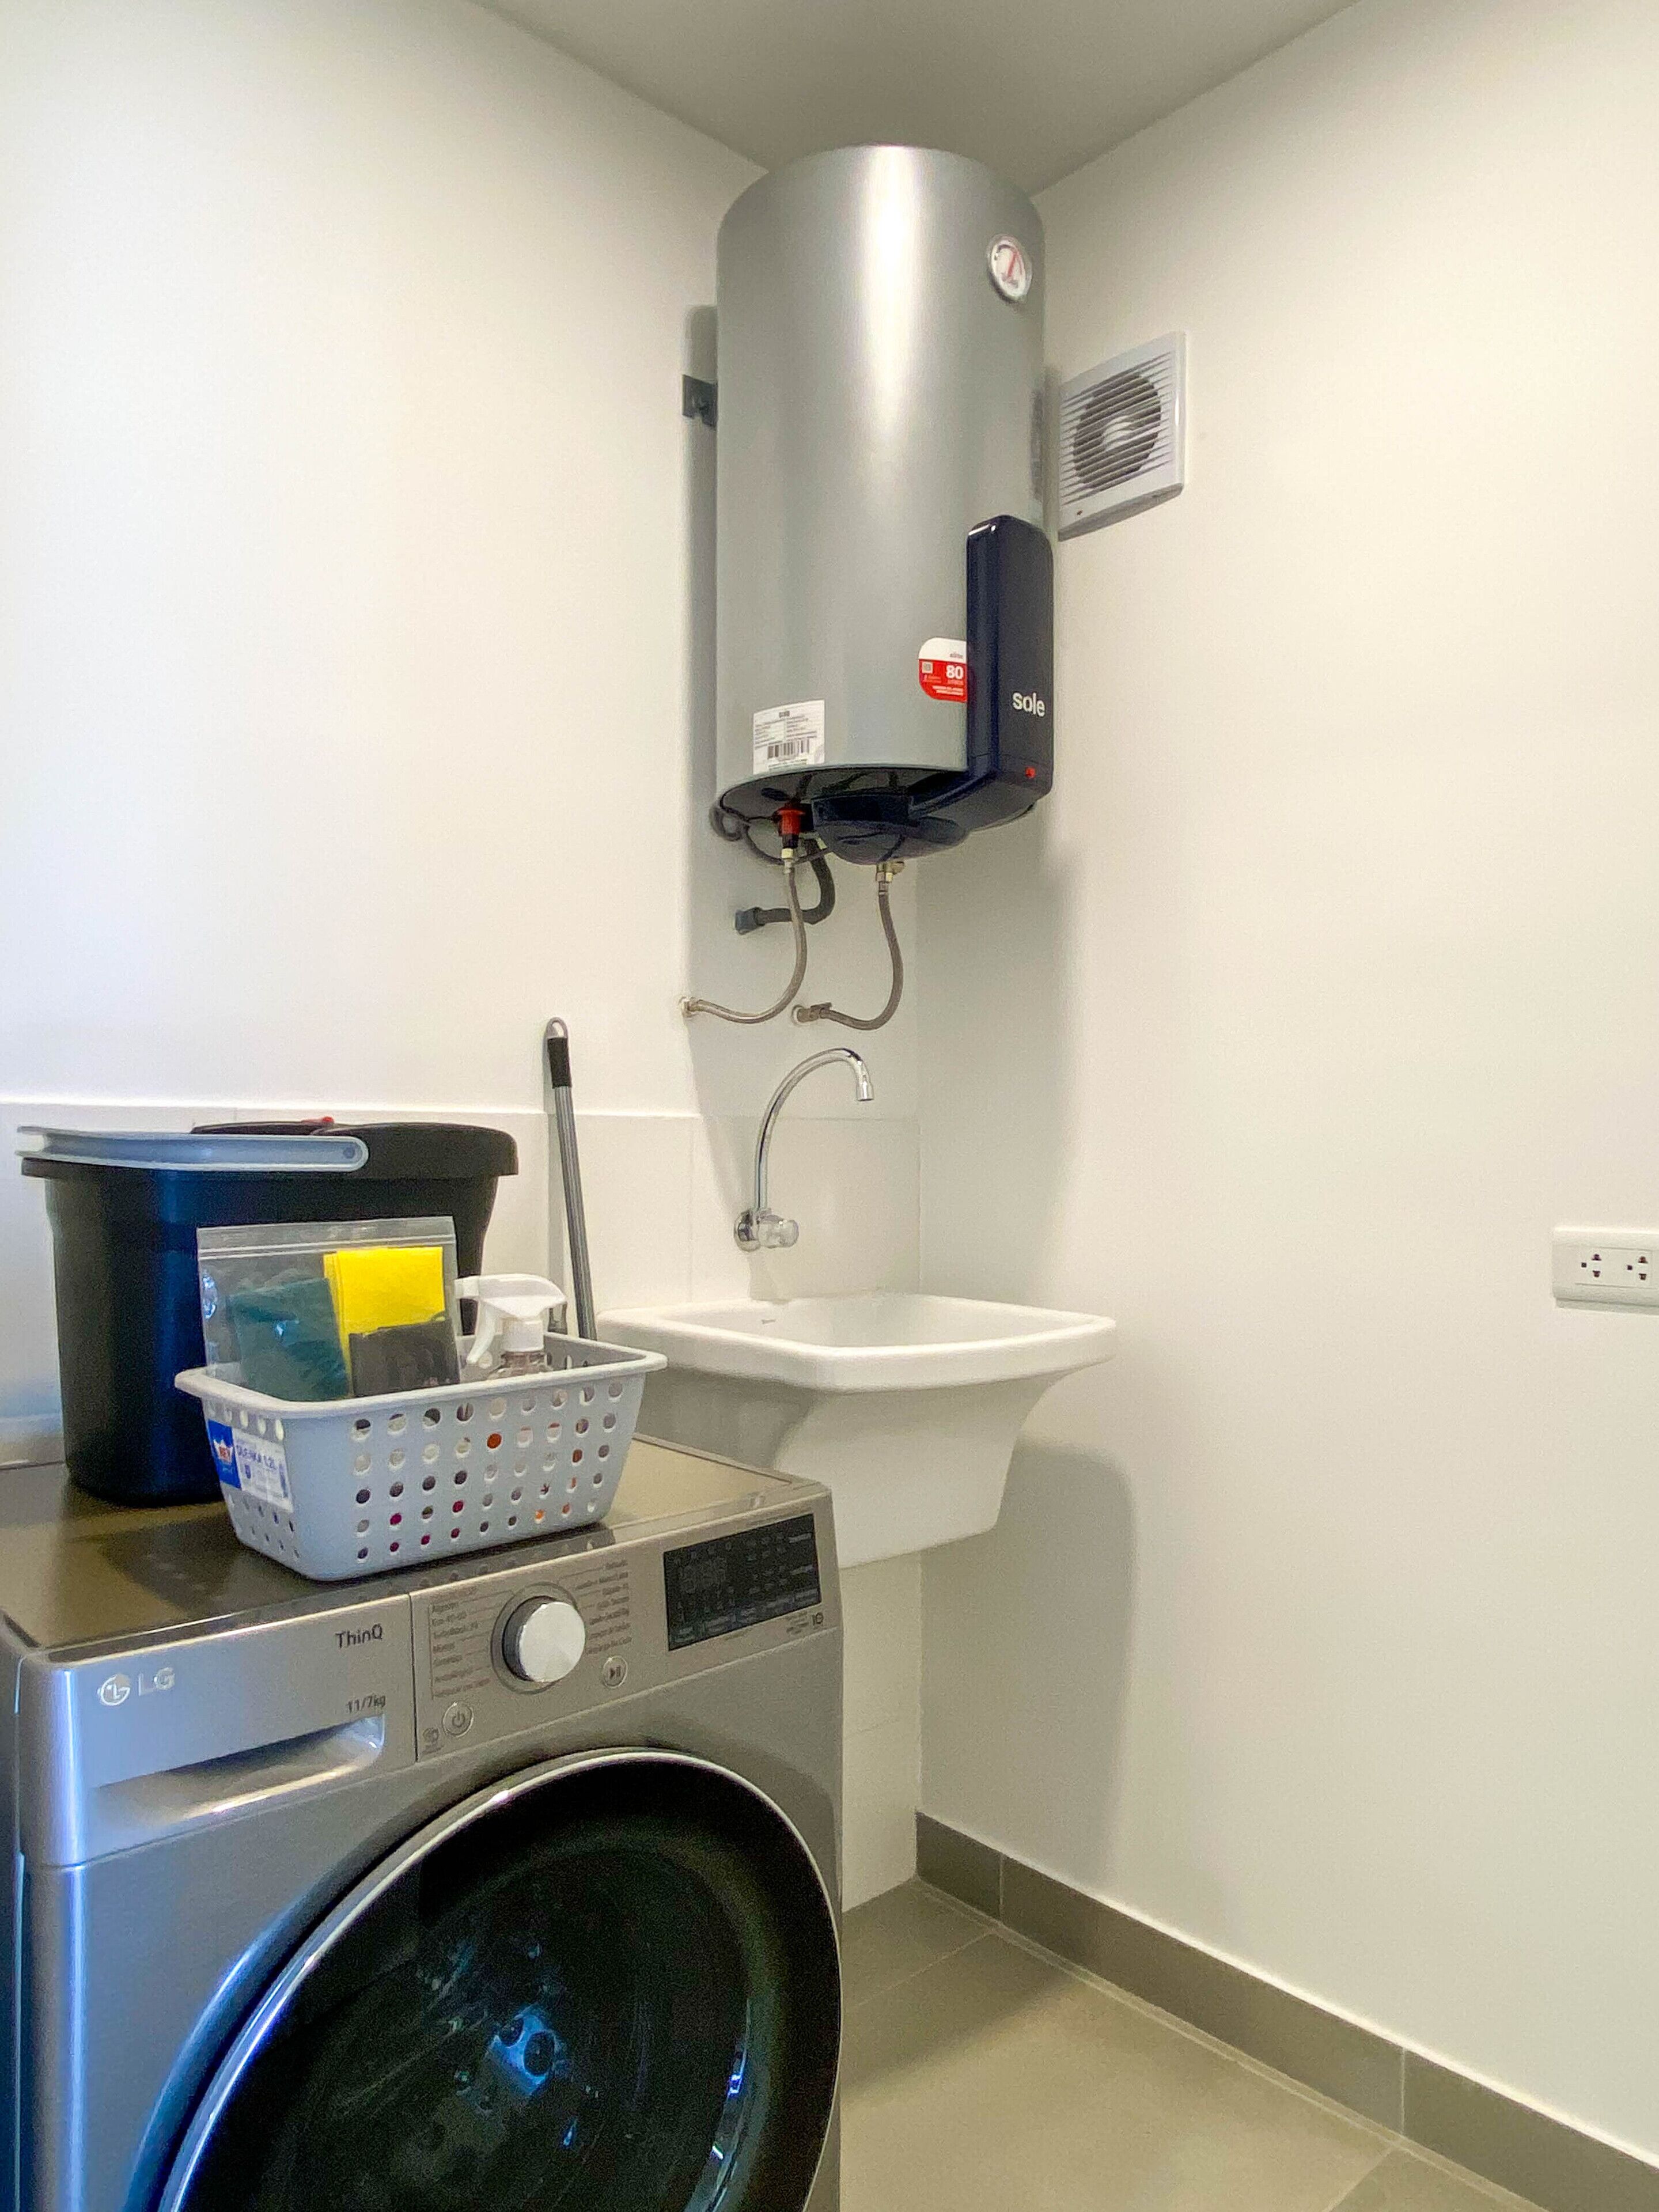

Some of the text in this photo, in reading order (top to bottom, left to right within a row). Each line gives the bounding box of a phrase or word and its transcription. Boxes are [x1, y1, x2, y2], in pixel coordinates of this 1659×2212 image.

[946, 664, 964, 680] 80
[1012, 692, 1046, 717] sole
[335, 1623, 383, 1649] ThinQ
[138, 1667, 176, 1697] LG
